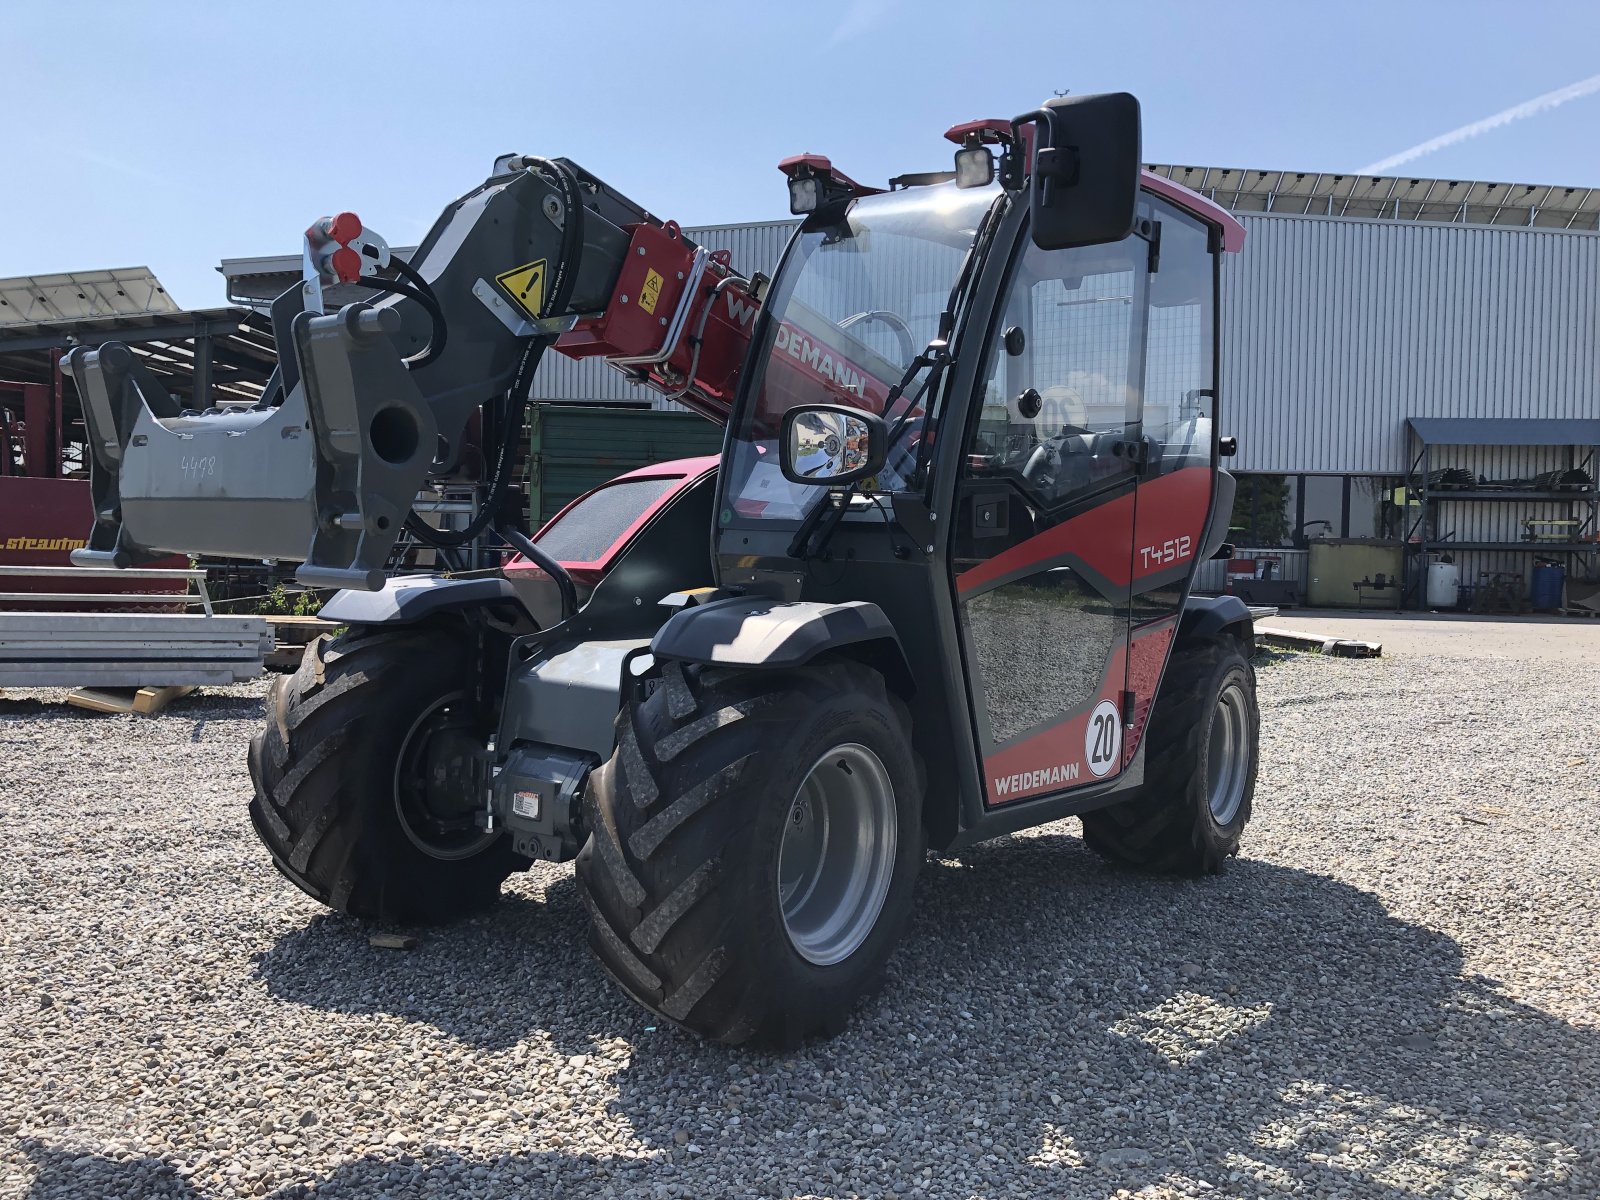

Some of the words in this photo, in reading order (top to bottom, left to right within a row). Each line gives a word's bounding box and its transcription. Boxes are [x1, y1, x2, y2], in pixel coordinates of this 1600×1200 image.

[727, 291, 867, 399] WDEMANN
[6, 536, 87, 550] strautm
[1140, 535, 1191, 569] T4512
[1091, 713, 1115, 763] 20
[994, 762, 1079, 796] WEIDEMANN
